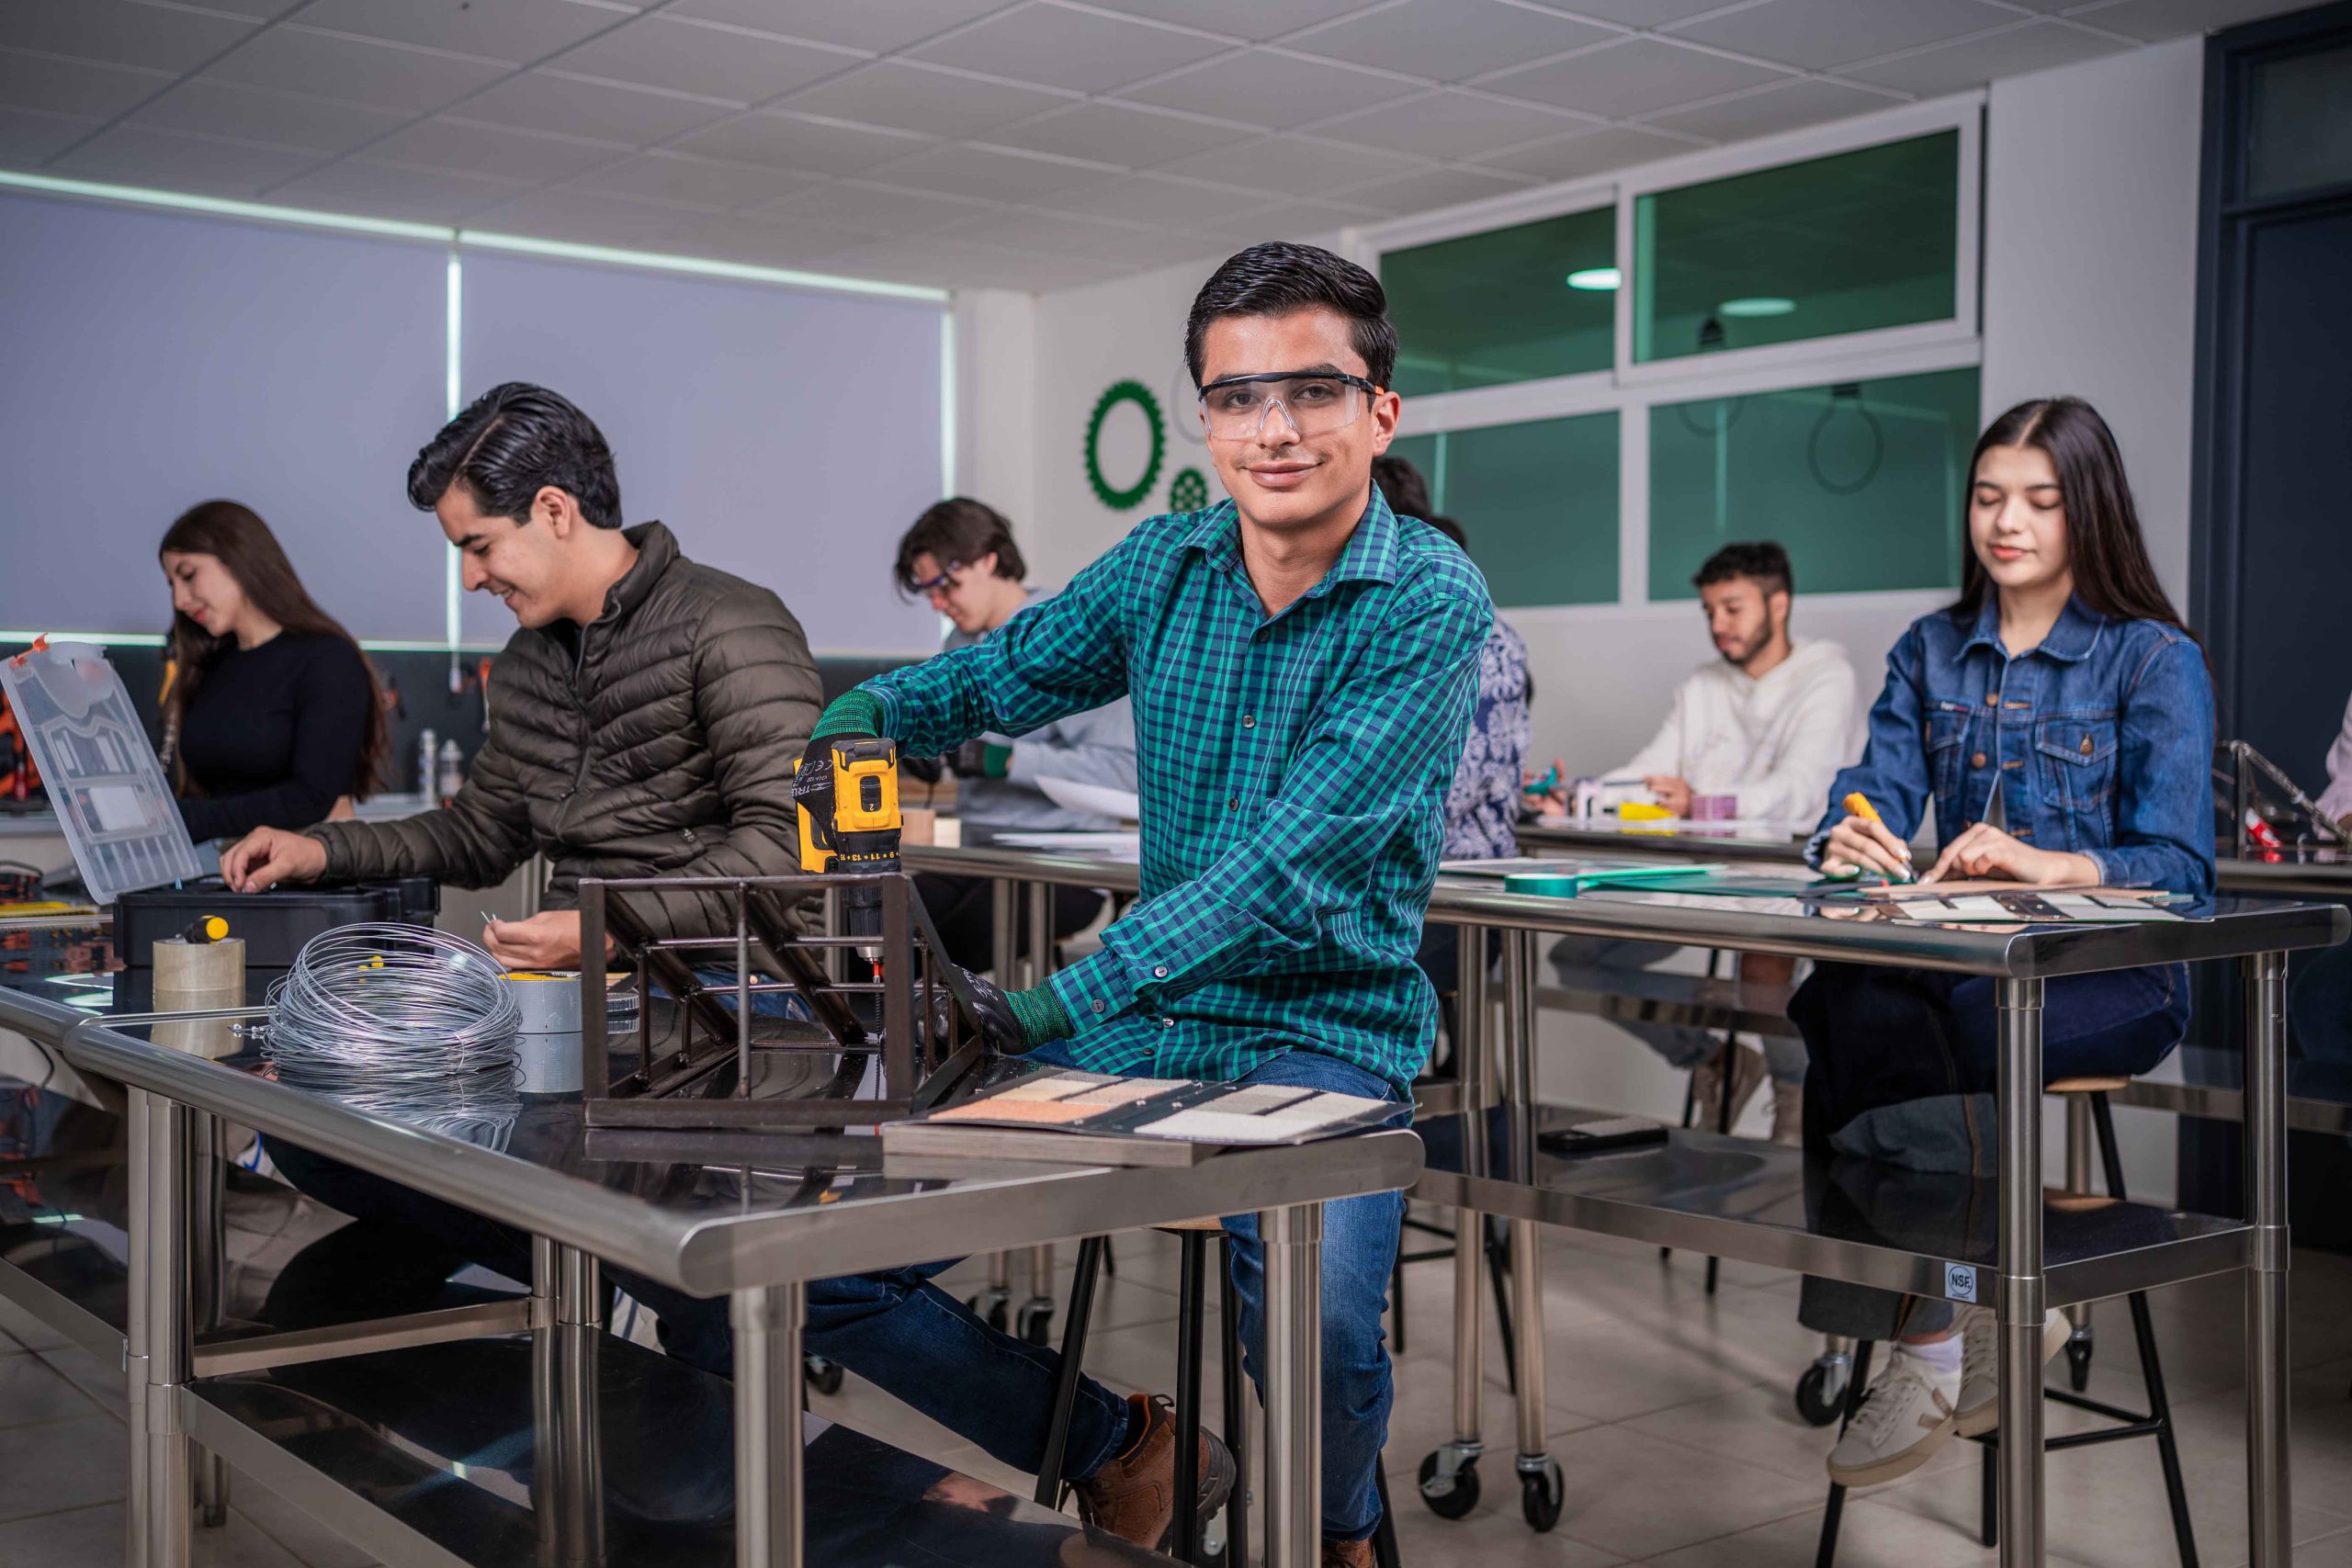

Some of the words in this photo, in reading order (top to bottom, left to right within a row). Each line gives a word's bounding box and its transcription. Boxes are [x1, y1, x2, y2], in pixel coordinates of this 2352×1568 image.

[869, 803, 875, 811] 2
[852, 853, 862, 862] 13
[870, 852, 881, 861] 11
[1951, 1273, 1971, 1289] NSF
